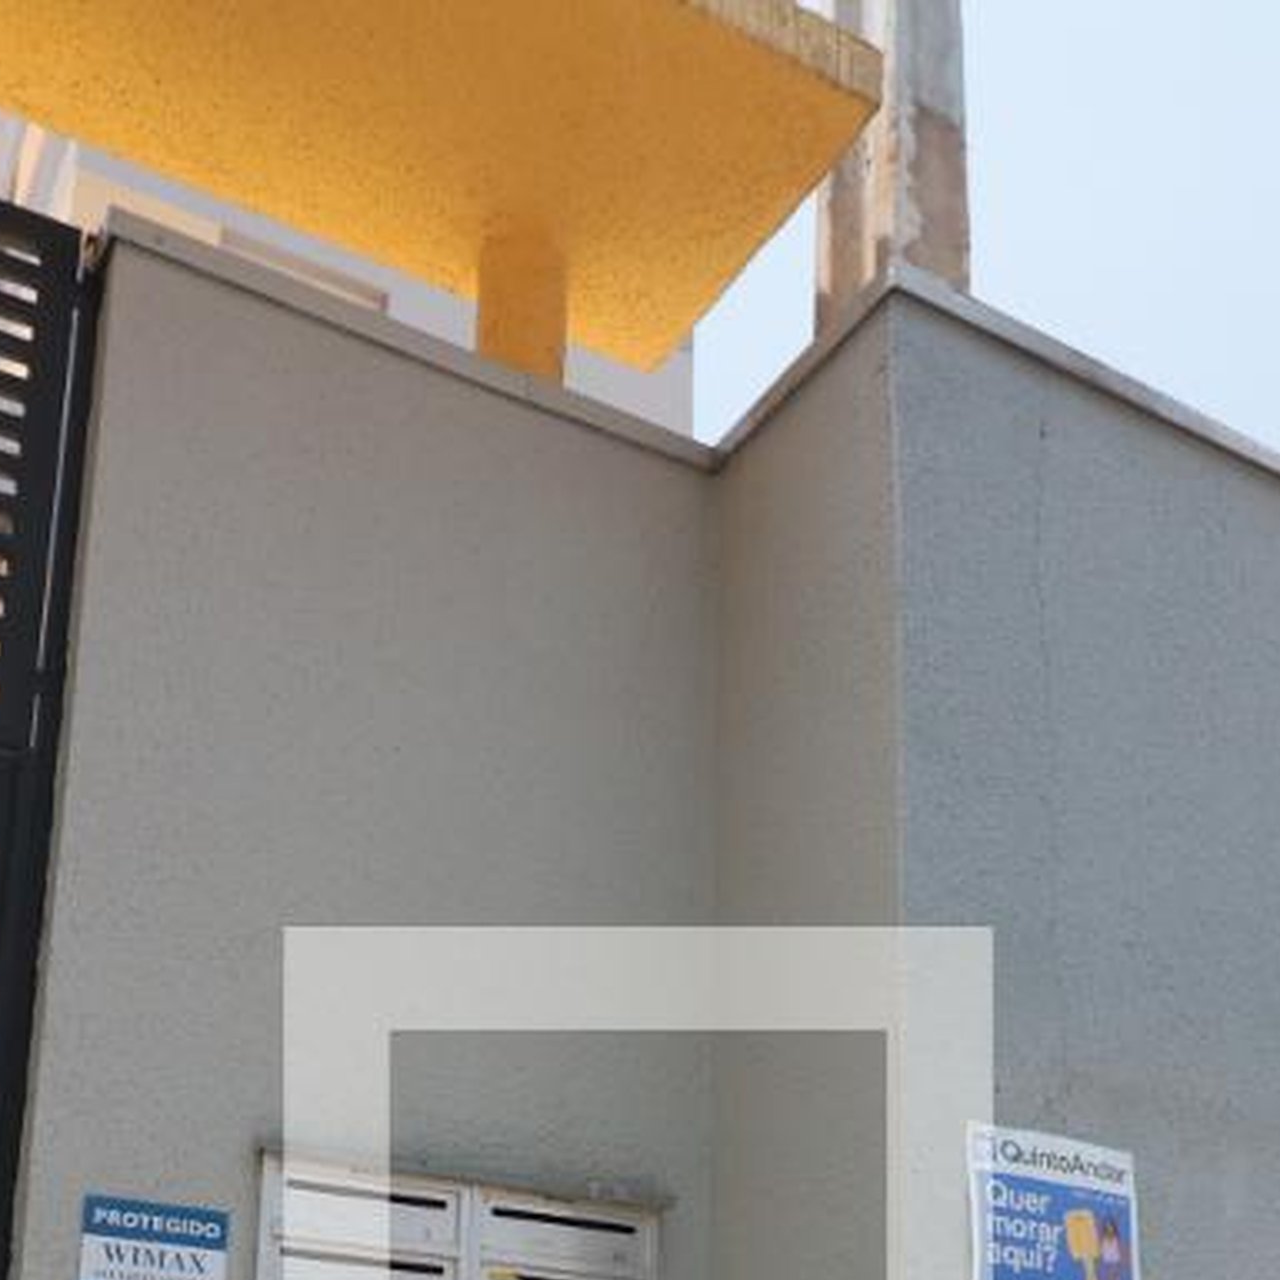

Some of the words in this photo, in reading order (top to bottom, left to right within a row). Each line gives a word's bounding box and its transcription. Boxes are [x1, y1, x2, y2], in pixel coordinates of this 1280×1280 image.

[1000, 1138, 1125, 1183] QuintoAndar
[986, 1180, 1052, 1213] Quer
[92, 1206, 222, 1239] PROTEGIDO
[987, 1214, 1064, 1245] morar
[103, 1242, 208, 1275] WIMAX
[987, 1241, 1056, 1273] aqui?
